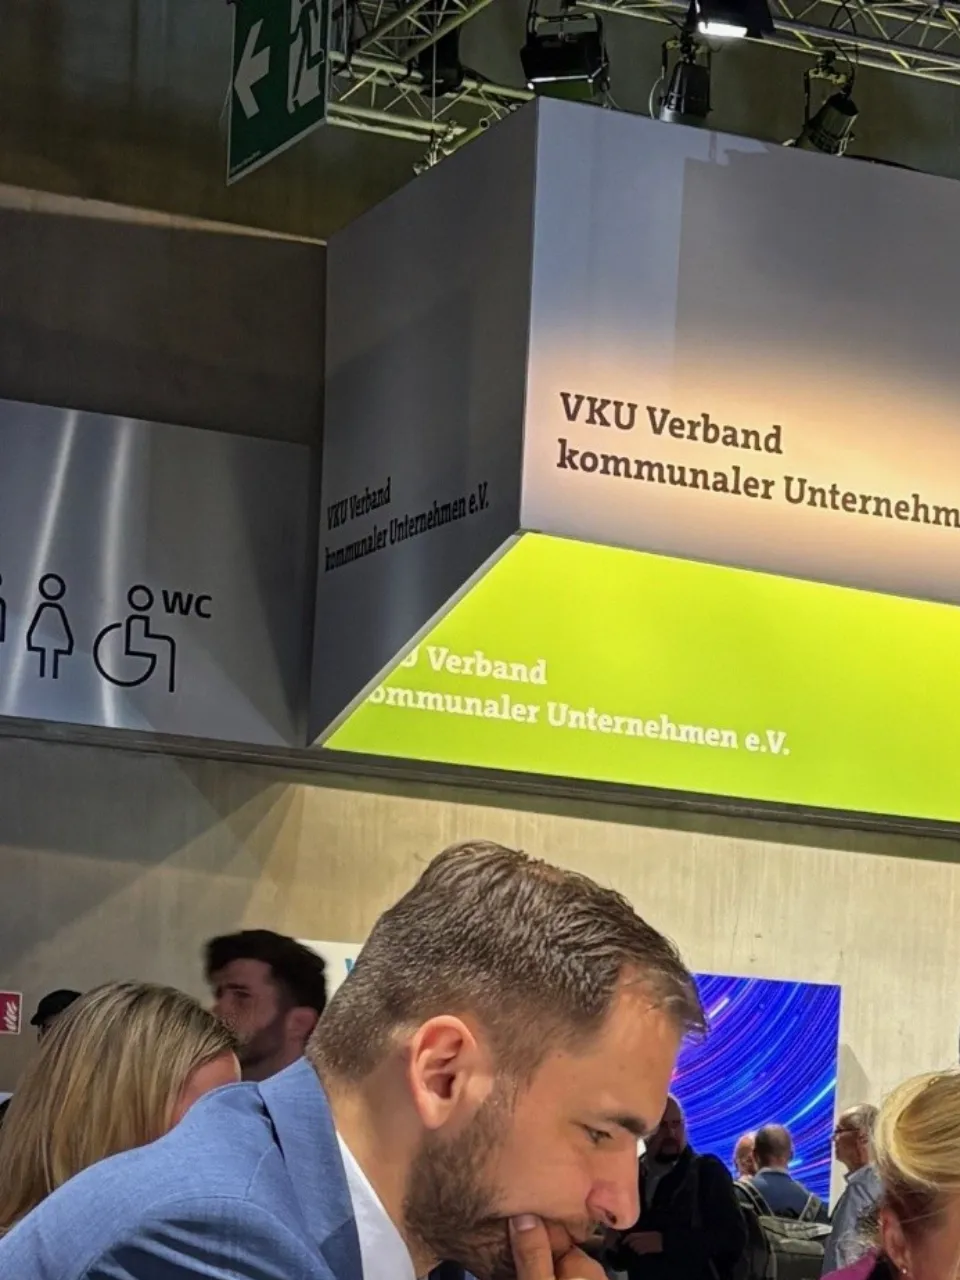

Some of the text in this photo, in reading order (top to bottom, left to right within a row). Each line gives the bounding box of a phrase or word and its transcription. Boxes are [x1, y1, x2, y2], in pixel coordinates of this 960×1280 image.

[559, 392, 784, 454] VKU Verband
[557, 439, 775, 500] kommunaler
[325, 481, 490, 572] kommunaler Unternehmen e.V.
[327, 476, 391, 531] VKU Verband
[162, 589, 212, 619] WC
[427, 645, 547, 685] Verband
[369, 684, 790, 756] ommunaler Unternehmen e.V.
